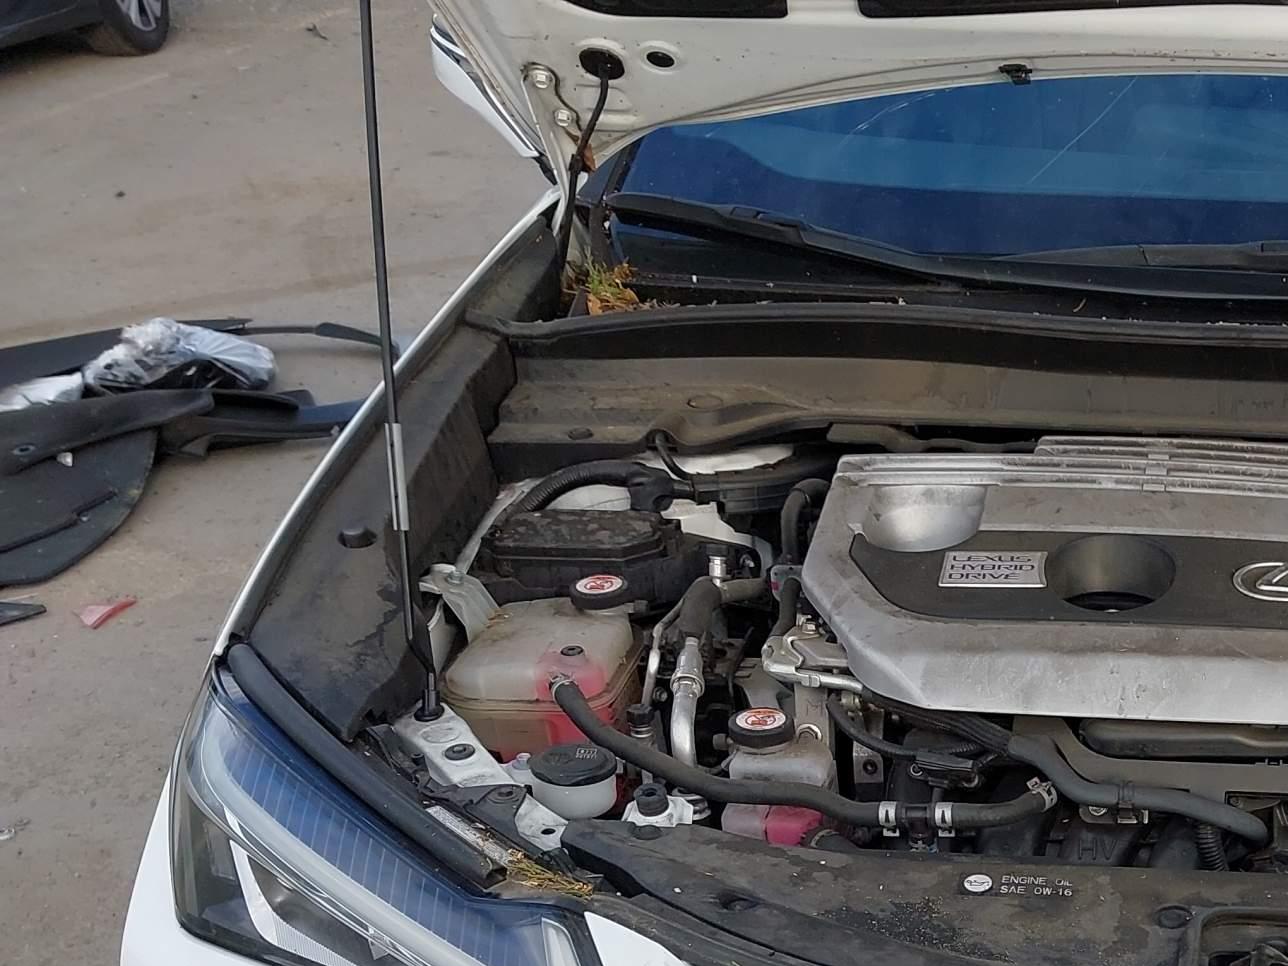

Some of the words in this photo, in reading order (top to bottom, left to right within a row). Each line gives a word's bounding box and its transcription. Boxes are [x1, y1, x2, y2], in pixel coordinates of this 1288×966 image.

[1001, 875, 1048, 886] ENGINE
[1055, 879, 1073, 887] OIL
[1000, 885, 1027, 895] SAE
